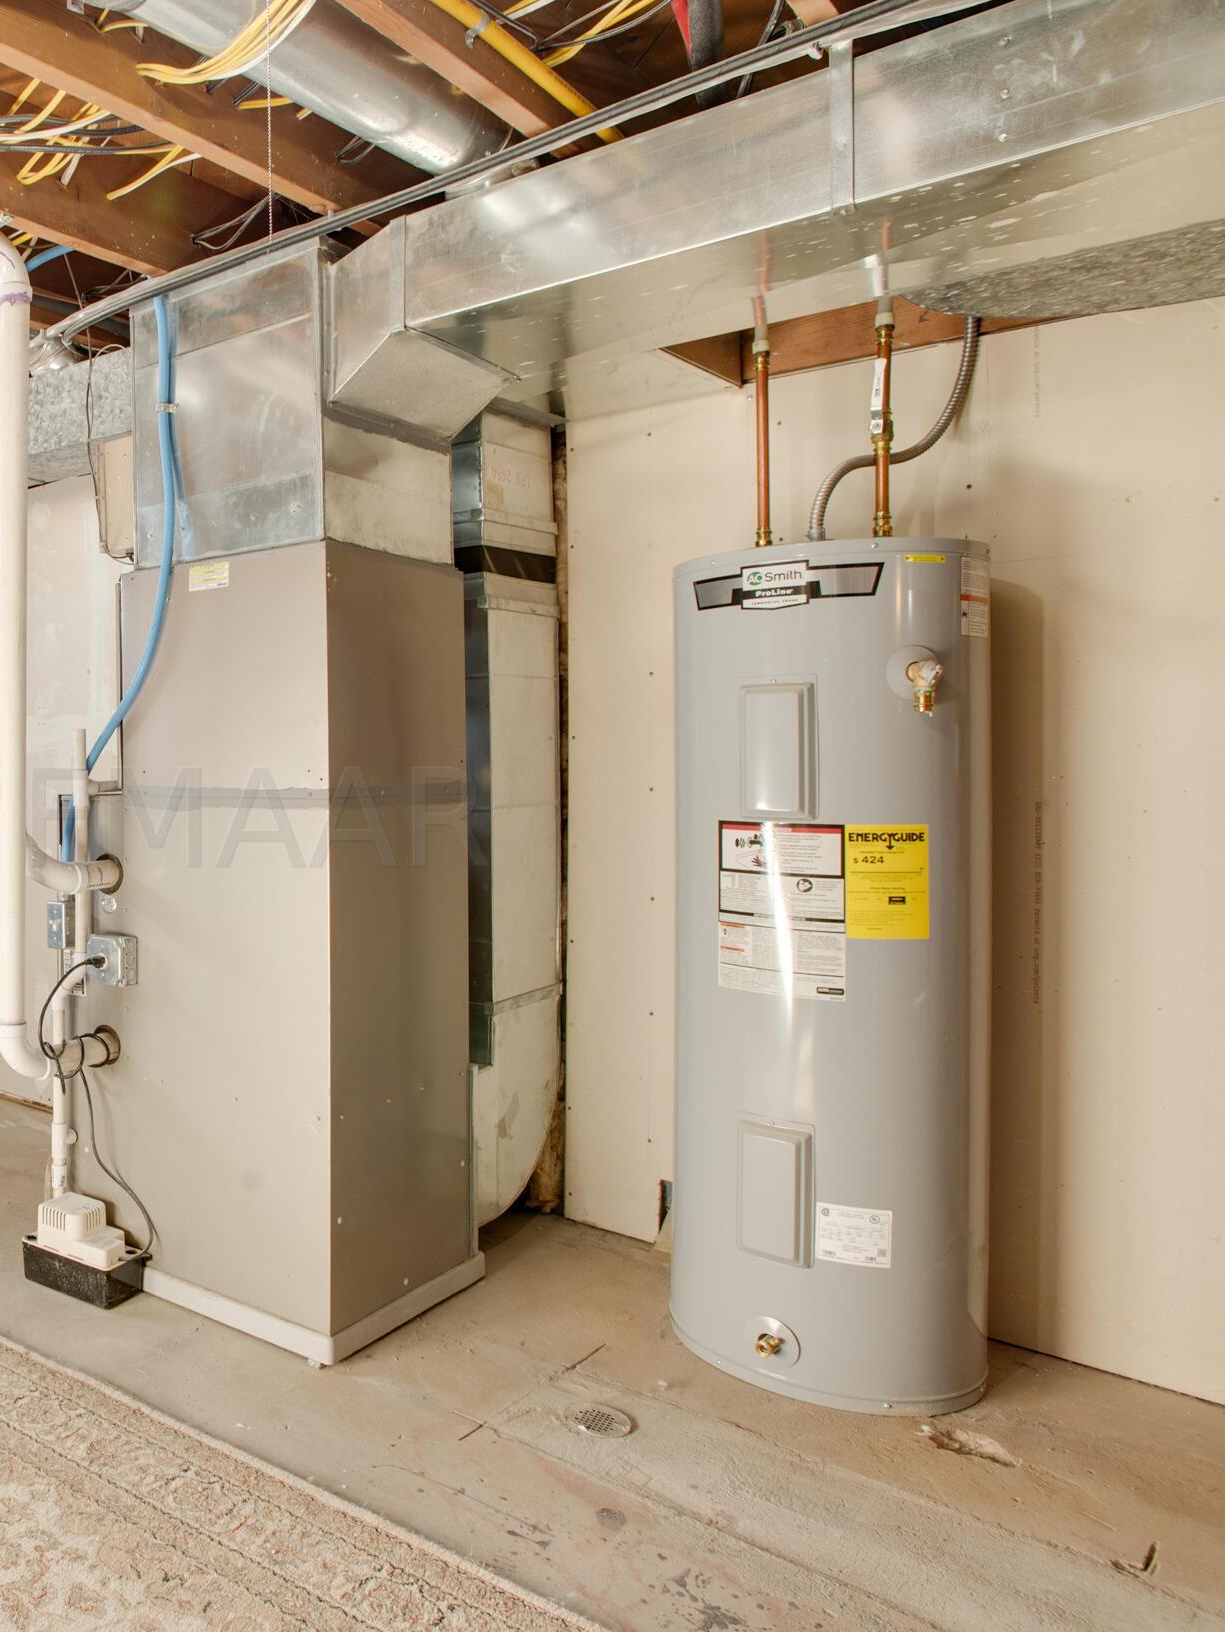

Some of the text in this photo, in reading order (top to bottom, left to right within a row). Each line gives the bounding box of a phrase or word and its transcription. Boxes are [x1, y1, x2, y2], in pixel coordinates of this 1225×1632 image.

[764, 569, 802, 583] Smith
[755, 588, 793, 598] ProLine
[861, 856, 885, 865] 424
